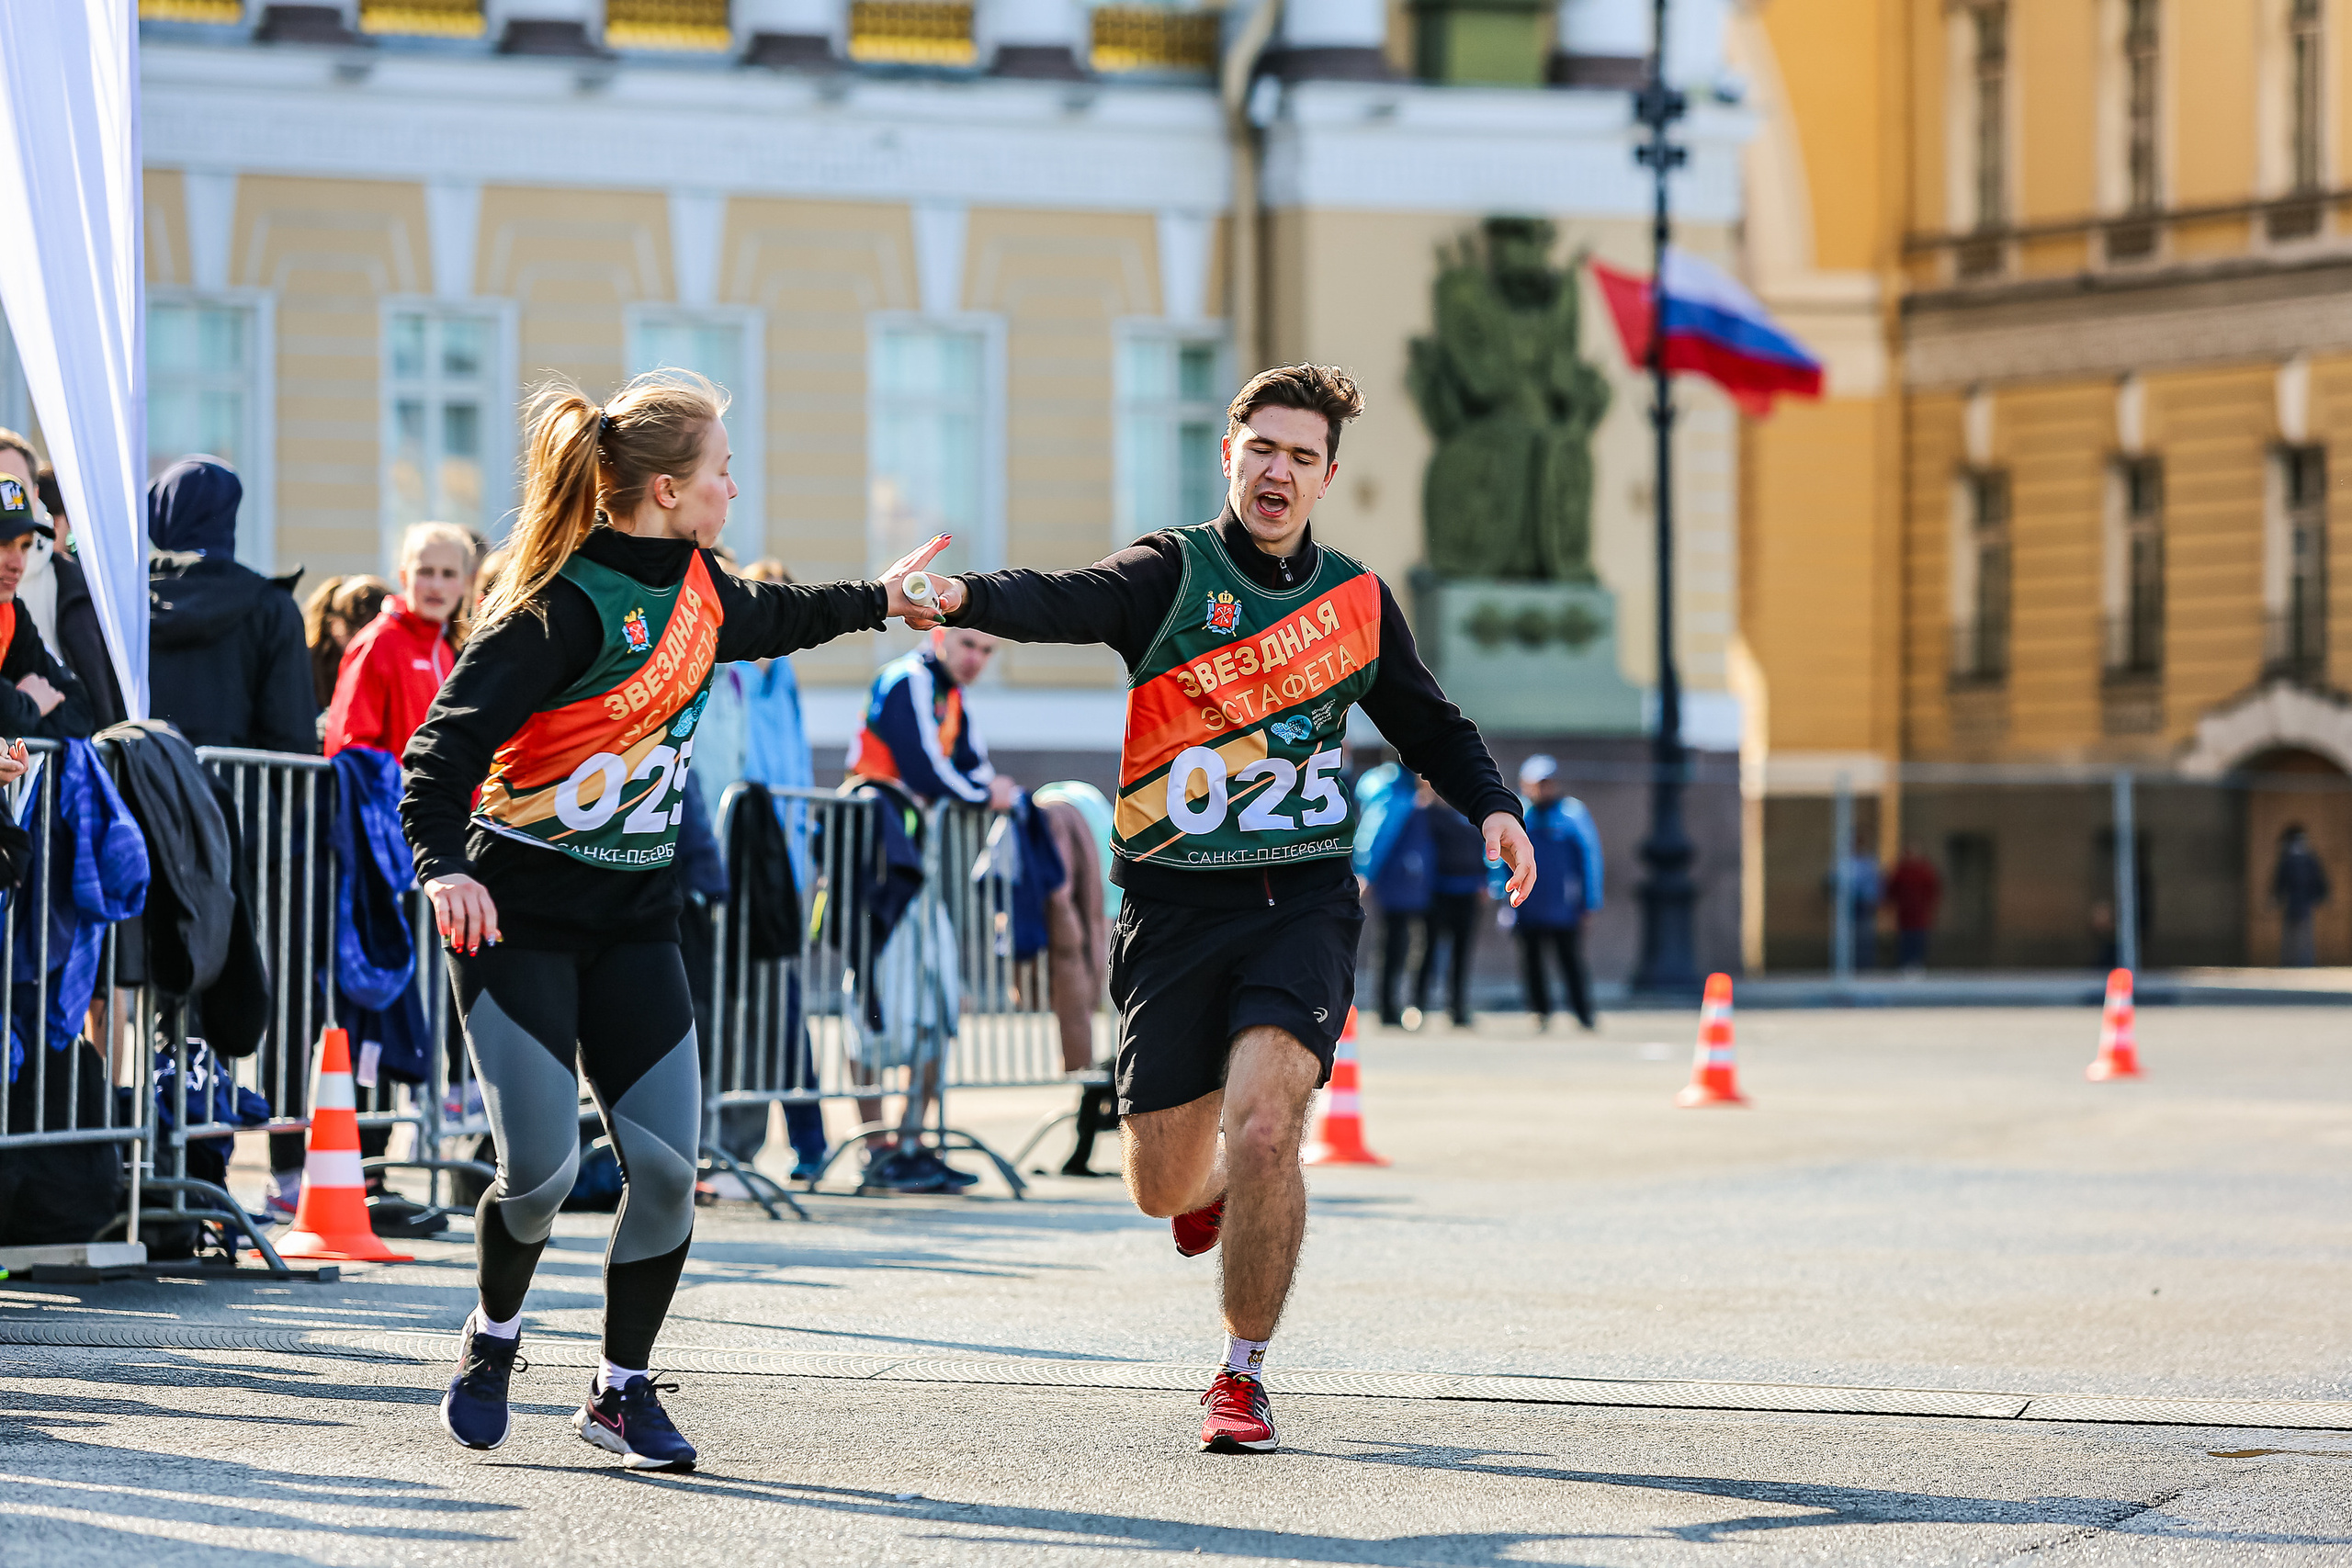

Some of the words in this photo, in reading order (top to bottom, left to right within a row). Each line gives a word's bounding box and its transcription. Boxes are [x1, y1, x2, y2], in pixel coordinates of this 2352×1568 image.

[604, 584, 703, 721] ЗВЕЗДНАЯ
[1176, 599, 1340, 698] ЗВЕЗДНАЯ
[1201, 644, 1358, 731] ЭСТАФЕТА
[1166, 746, 1348, 835] 025
[1187, 838, 1340, 864] САНКТ-ПЕТЕРБУРГ
